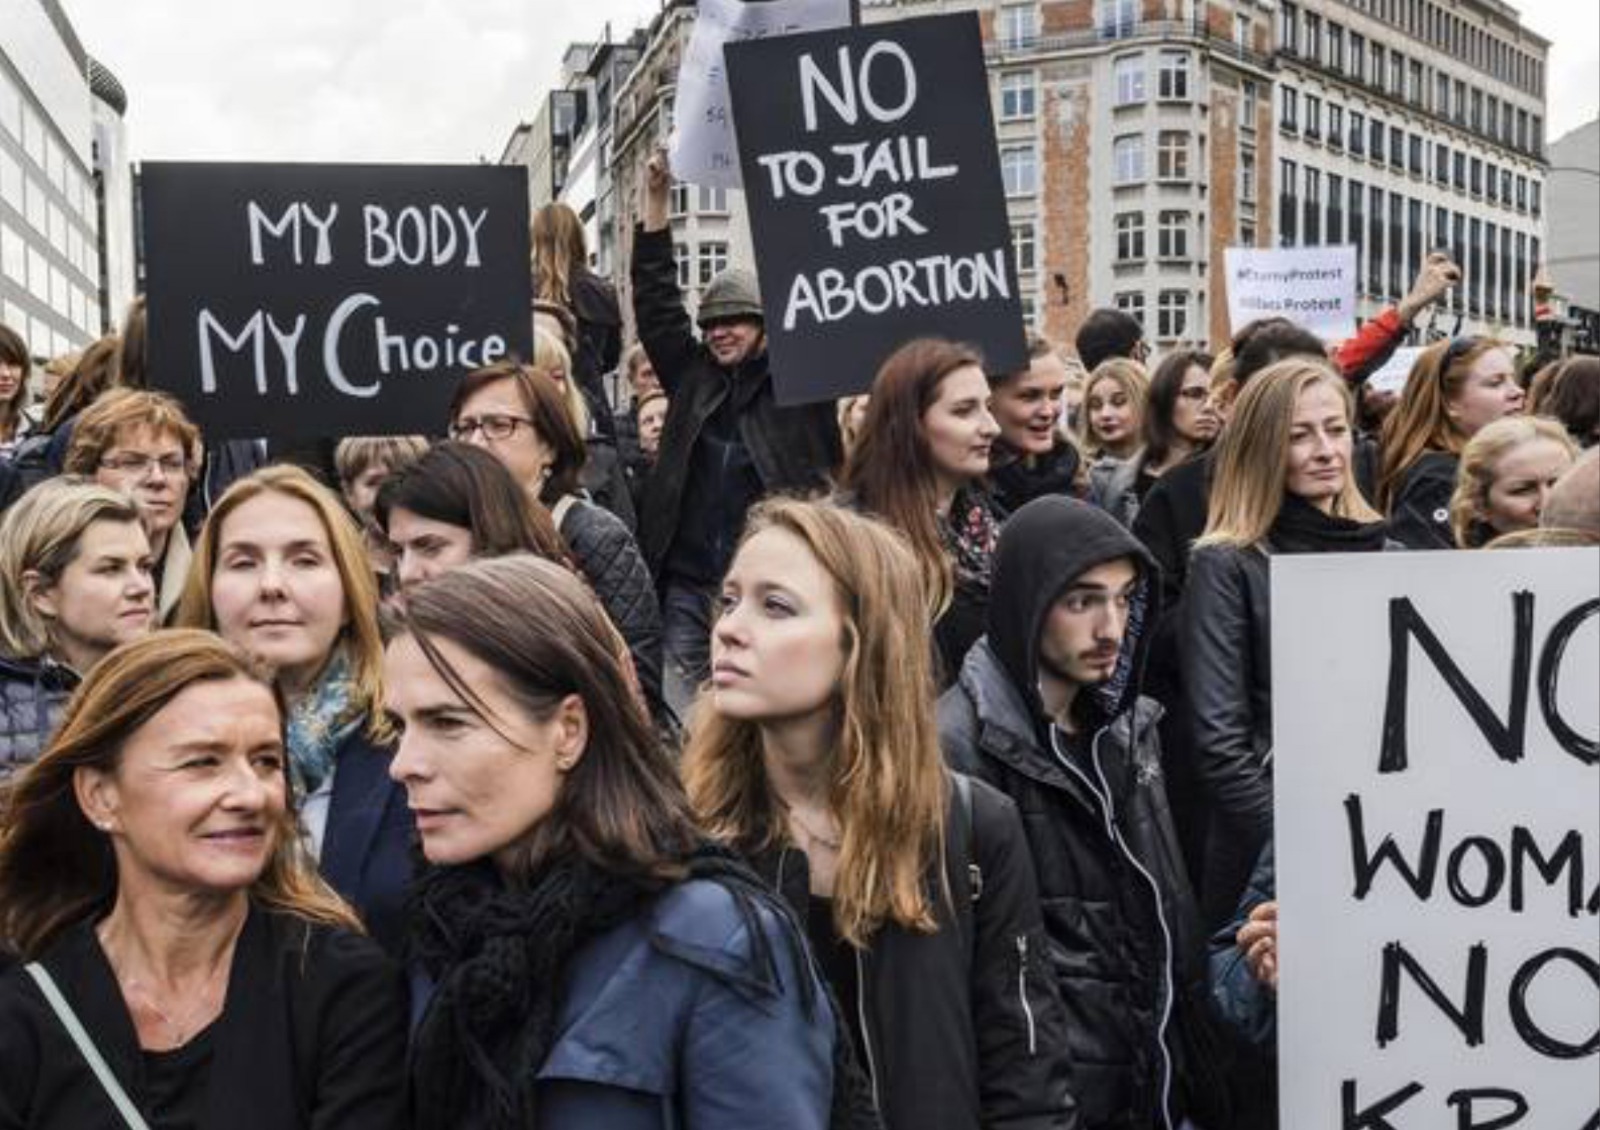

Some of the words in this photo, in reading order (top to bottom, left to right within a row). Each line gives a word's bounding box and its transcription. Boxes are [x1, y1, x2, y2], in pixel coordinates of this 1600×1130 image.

[798, 40, 917, 132] NO
[757, 150, 825, 199] TO
[831, 136, 959, 188] JAIL
[247, 200, 339, 266] MY
[363, 202, 488, 267] BODY
[818, 193, 928, 248] FOR
[783, 248, 1011, 331] ABORTION
[198, 308, 307, 395] MY
[323, 292, 506, 398] Choice
[1343, 793, 1599, 917] WOM
[1375, 940, 1599, 1060] NO
